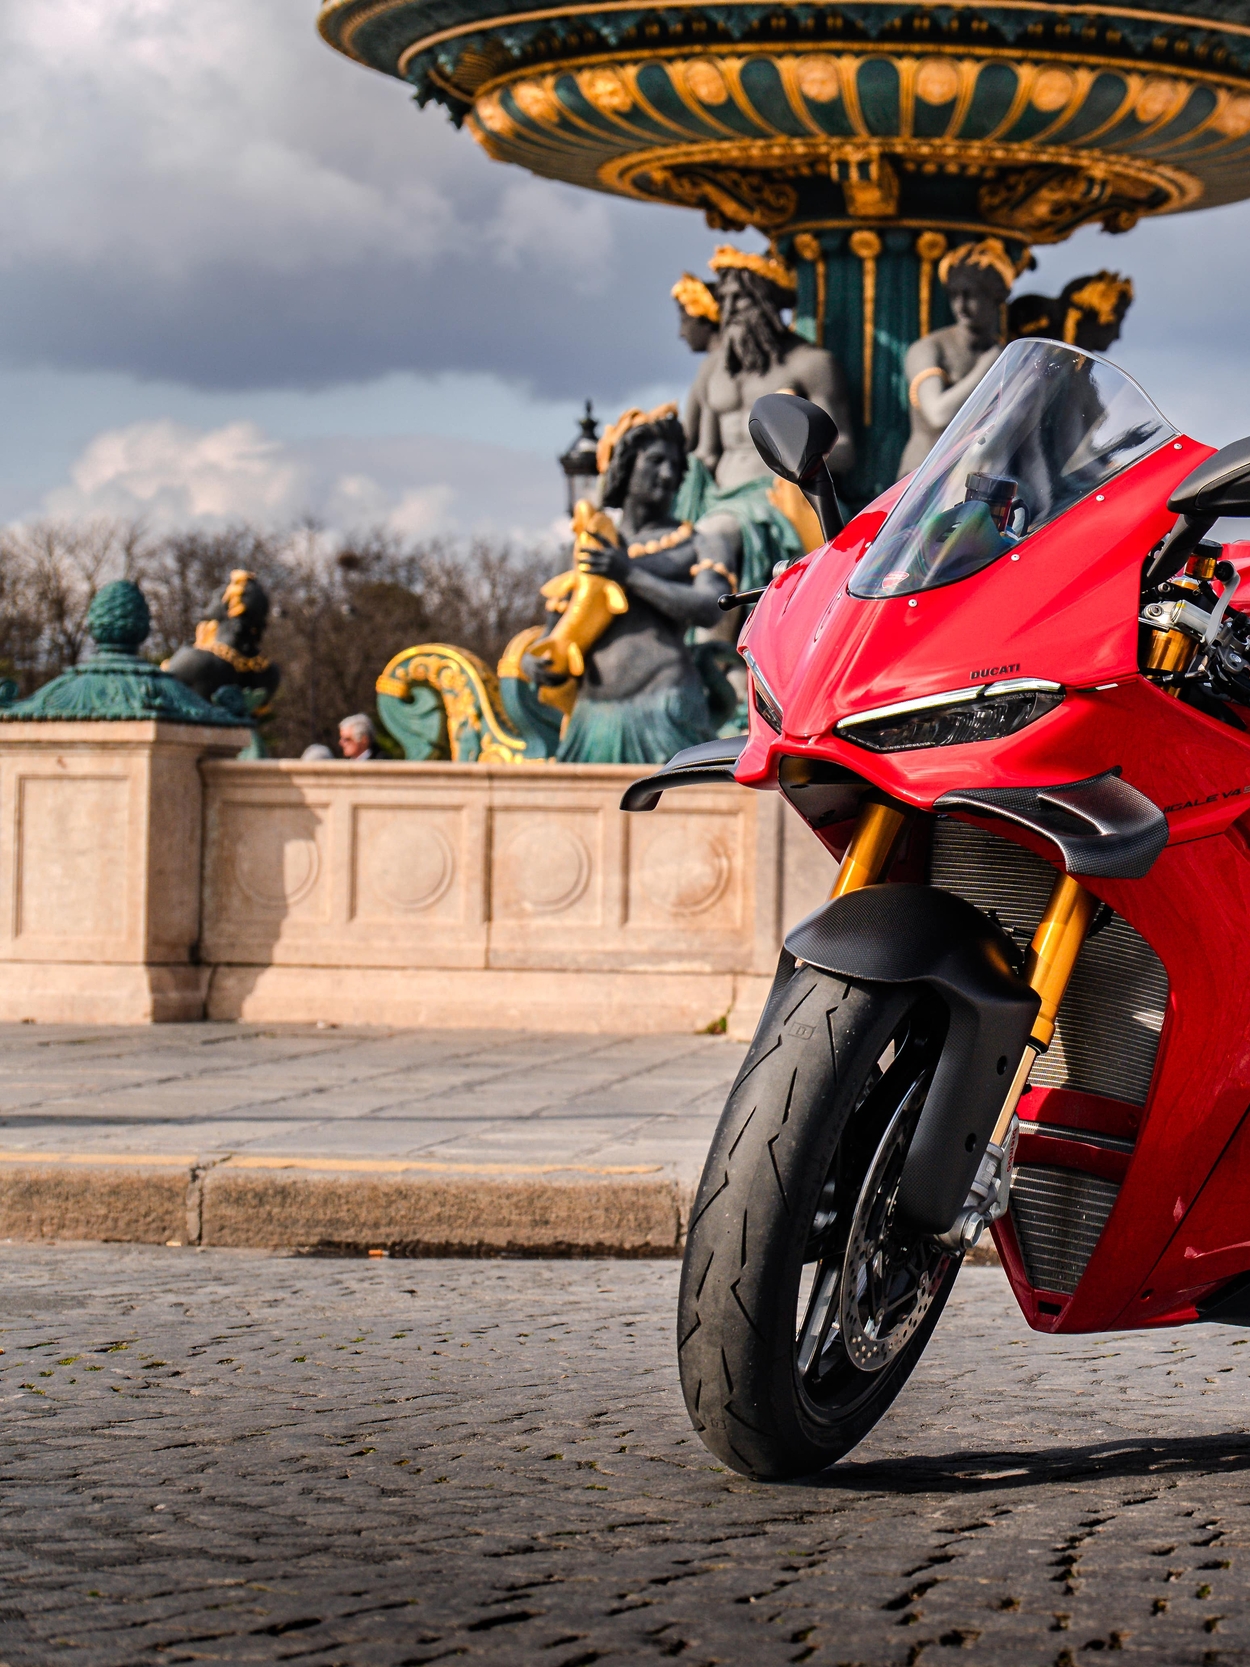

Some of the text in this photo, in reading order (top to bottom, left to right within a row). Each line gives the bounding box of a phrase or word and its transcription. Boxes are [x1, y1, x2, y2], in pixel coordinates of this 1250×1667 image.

[969, 663, 1021, 680] DUCATI
[1163, 793, 1219, 814] IGALE
[1221, 788, 1242, 799] V4
[1006, 1127, 1019, 1173] brembo
